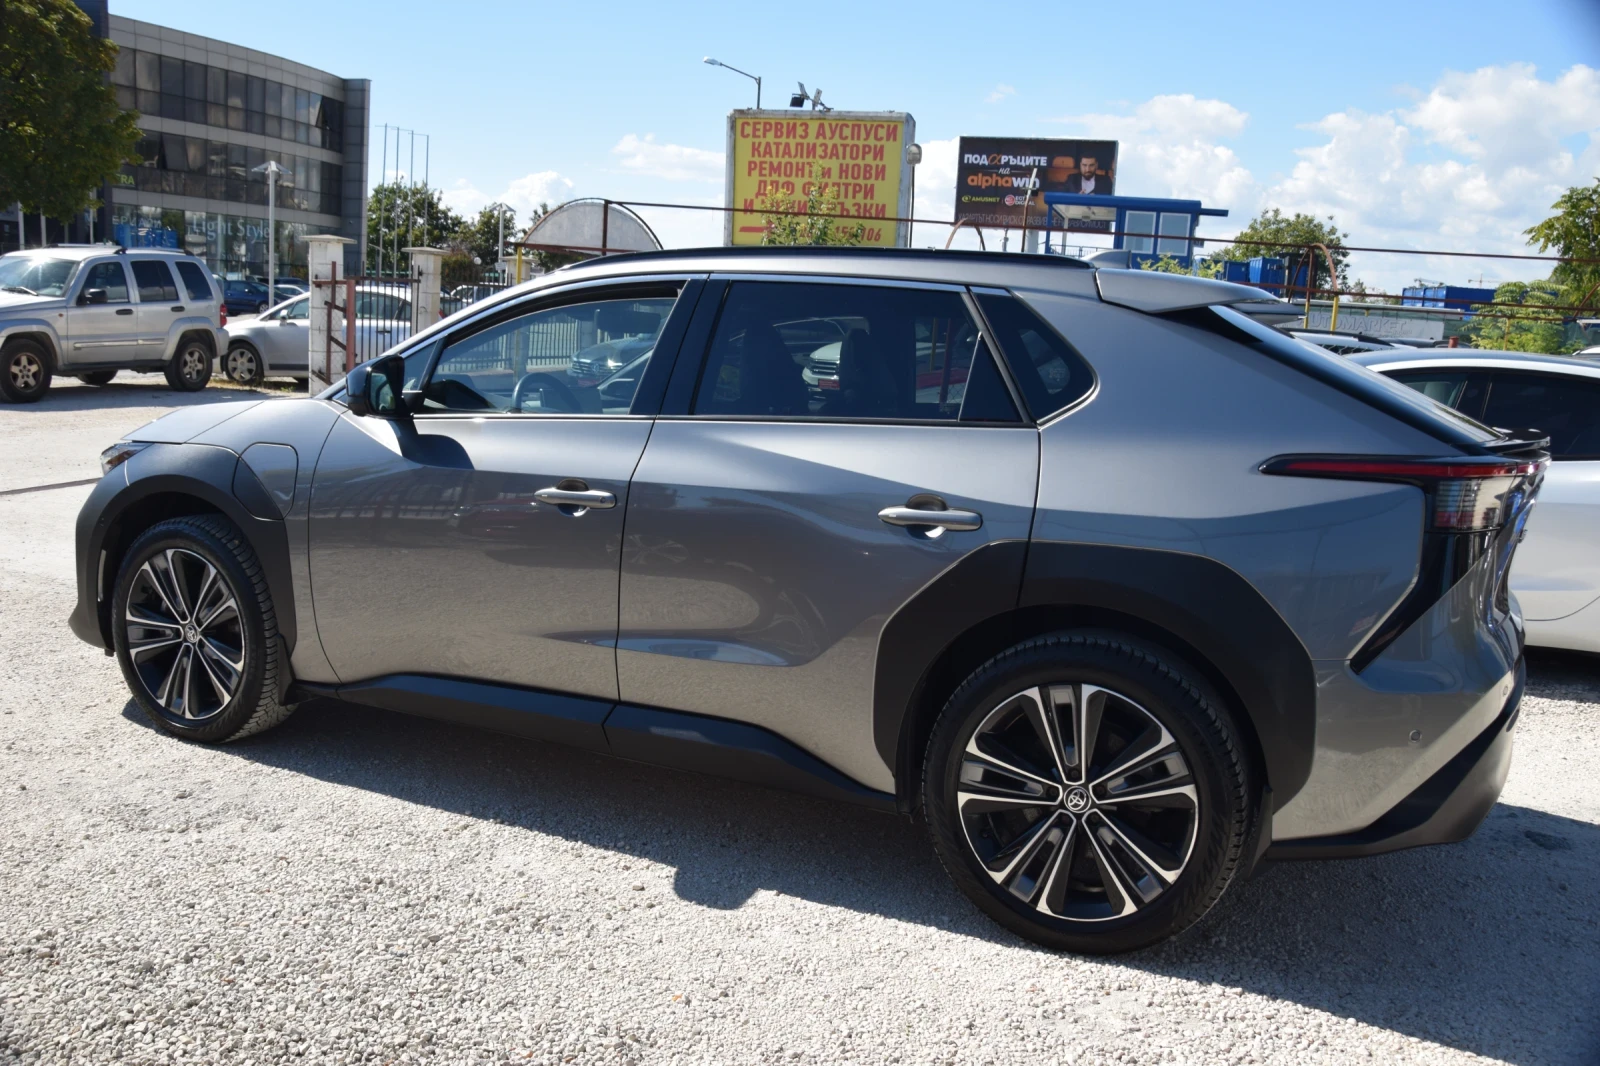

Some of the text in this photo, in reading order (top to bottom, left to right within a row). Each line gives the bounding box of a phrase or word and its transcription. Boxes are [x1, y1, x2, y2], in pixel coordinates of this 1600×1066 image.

[740, 121, 898, 142] СЕРВИЗ АУСПУСИ
[751, 141, 884, 161] КАТАЛИЗАТОРИ
[116, 173, 135, 185] RA
[747, 161, 814, 178] РЕМОНТ
[839, 164, 886, 181] НОВИ
[998, 167, 1011, 175] на
[967, 173, 1040, 189] alphawin
[743, 199, 754, 215] И
[193, 214, 270, 243] Light Style
[1300, 313, 1408, 332] UTOMARKET
